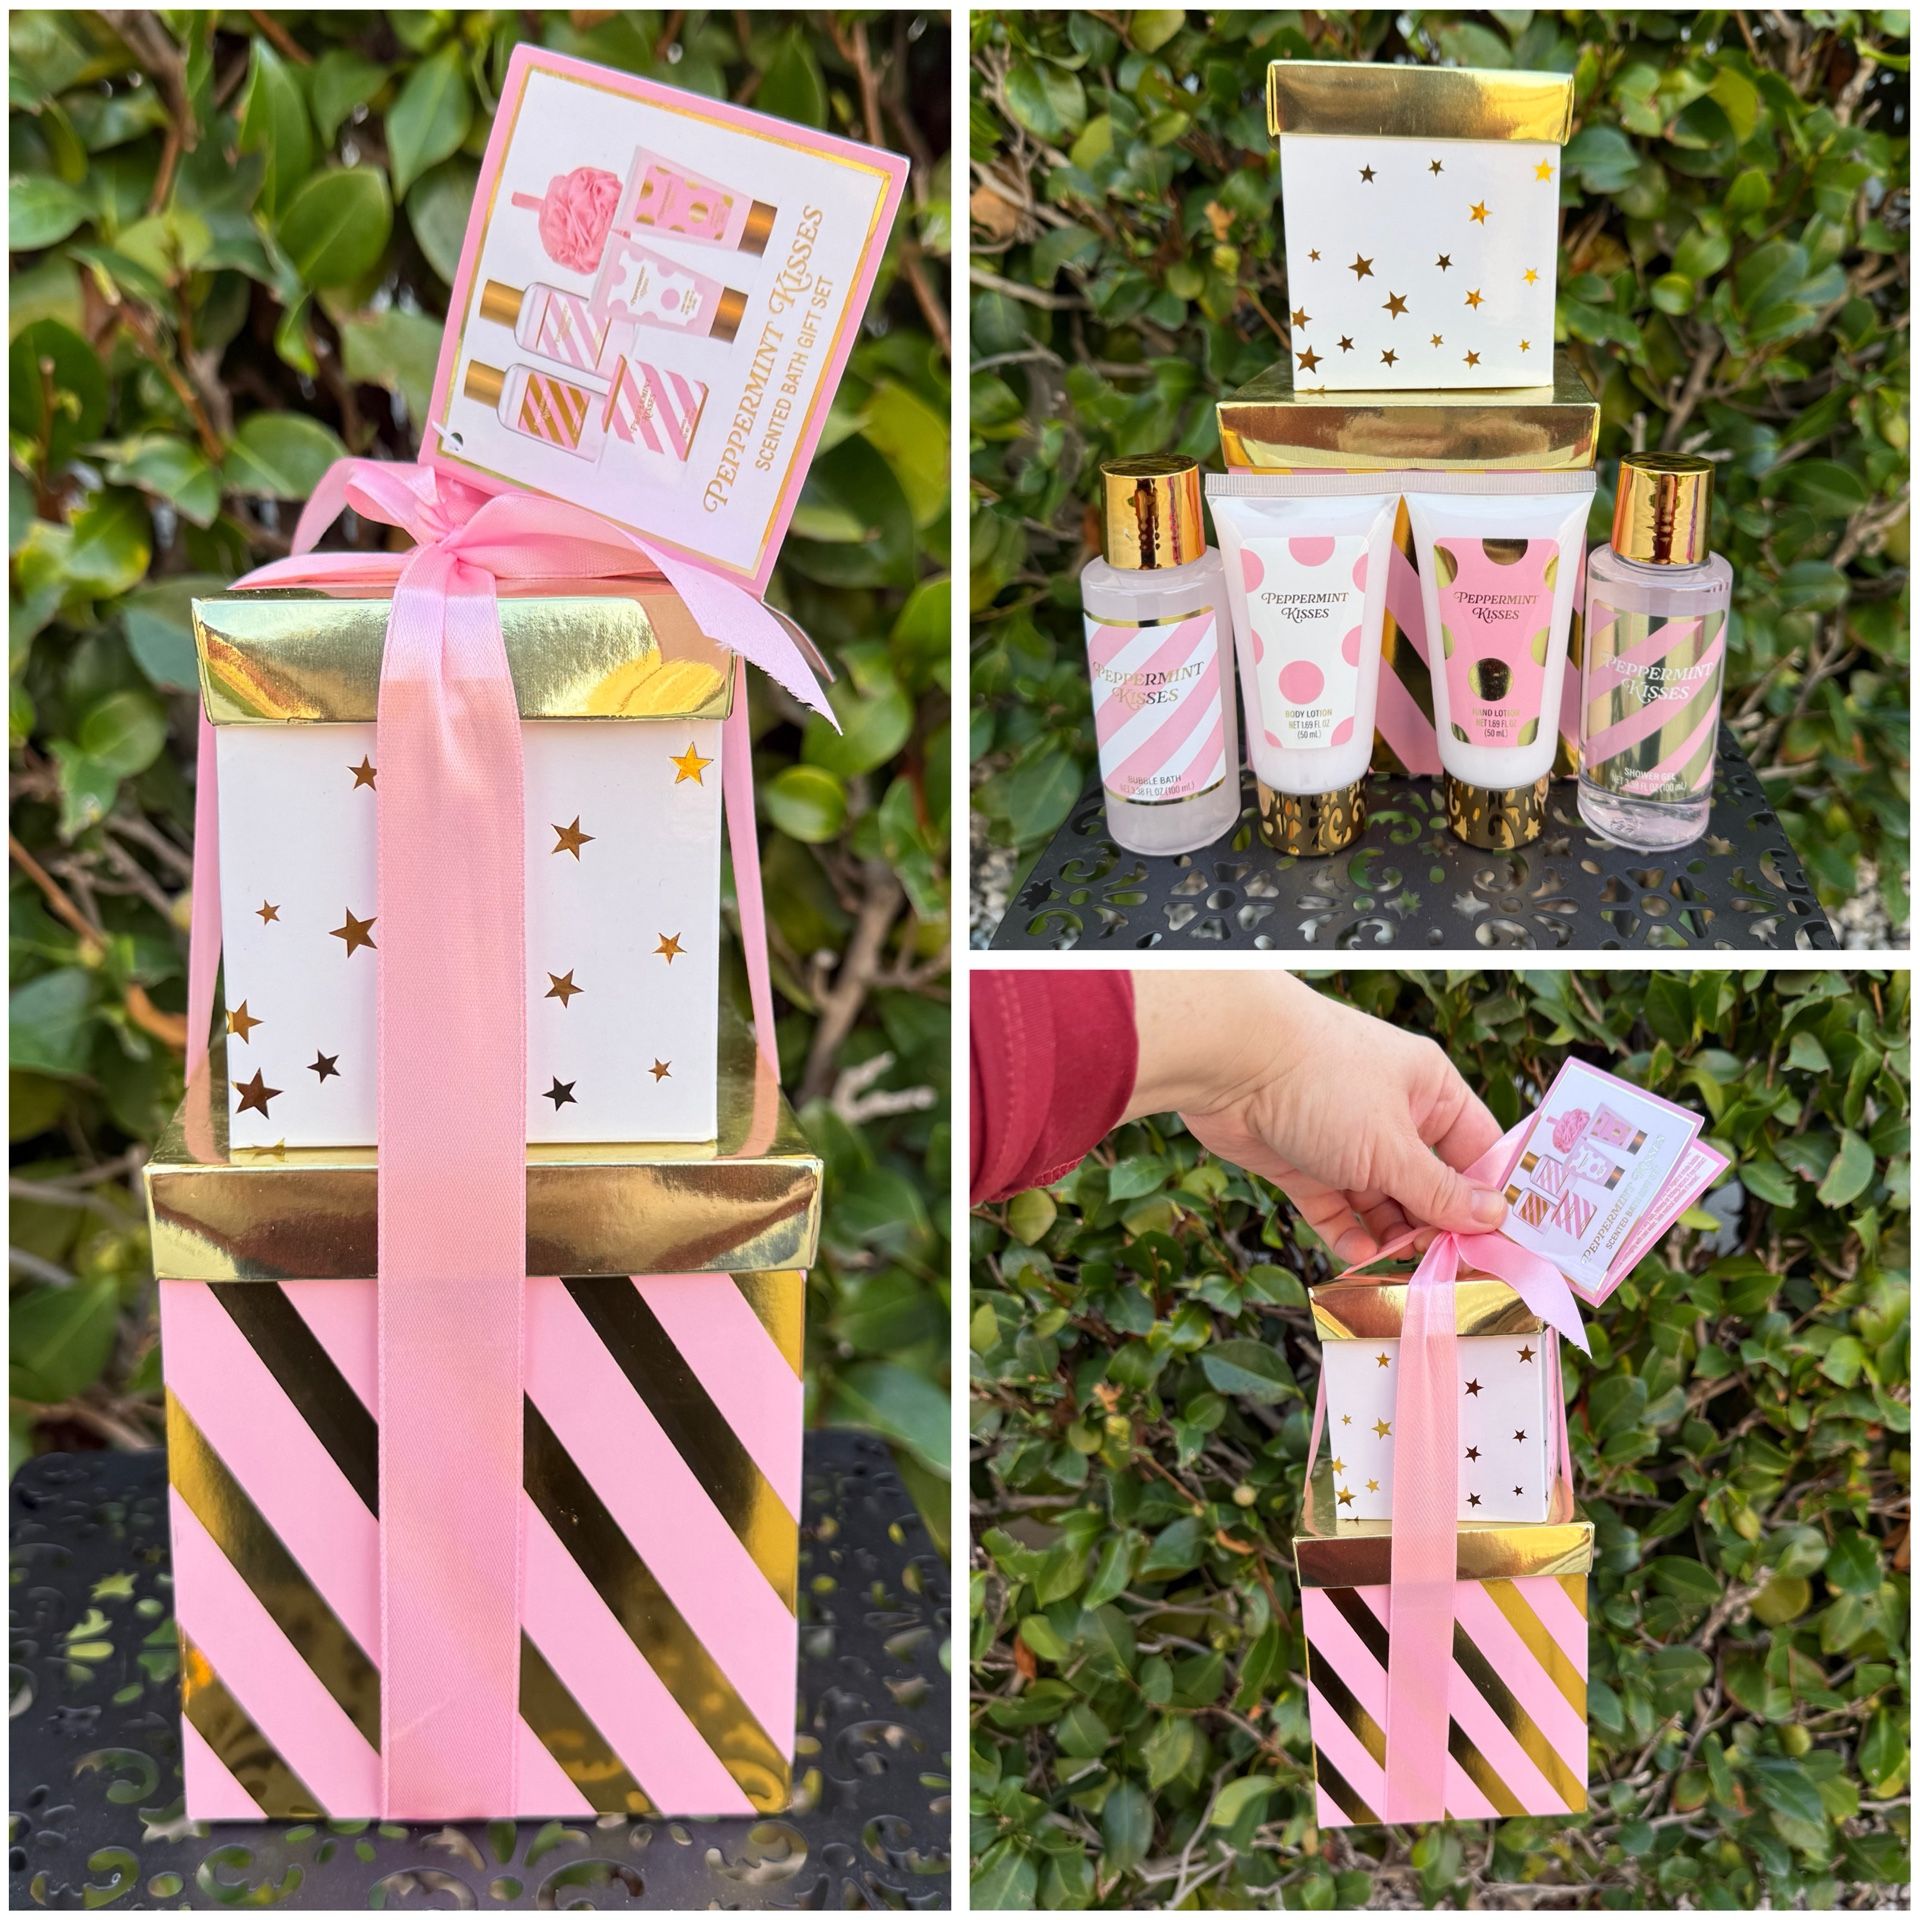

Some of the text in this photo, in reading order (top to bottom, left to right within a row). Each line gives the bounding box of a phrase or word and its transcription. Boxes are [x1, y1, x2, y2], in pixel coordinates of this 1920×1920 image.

[703, 204, 824, 513] PEPPERMINT KISSES
[755, 275, 834, 472] SCENTED BATH GIFT SET
[1261, 591, 1350, 605] PEPPERMINT
[1454, 591, 1539, 605] PEPPERMINT
[1281, 607, 1330, 624] KISSES
[1472, 607, 1520, 624] KISSES
[1602, 651, 1714, 681] PEPPERMINT
[1093, 661, 1205, 687] PEPPERMINT
[1621, 677, 1690, 704] KISSES
[1112, 687, 1179, 711] KISSES
[1285, 708, 1333, 718] BODY LOTION
[1472, 708, 1493, 717] HAND
[1288, 719, 1331, 729] NET 1.69 FL OZ
[1501, 719, 1508, 728] FL
[1297, 730, 1309, 739] (50
[1128, 774, 1182, 785] BUBBLE BATH
[1624, 767, 1660, 780] SHOWER
[1146, 787, 1153, 796] FL
[1581, 1182, 1633, 1264] PEPPERMINT
[1605, 1217, 1629, 1249] SCENTED
